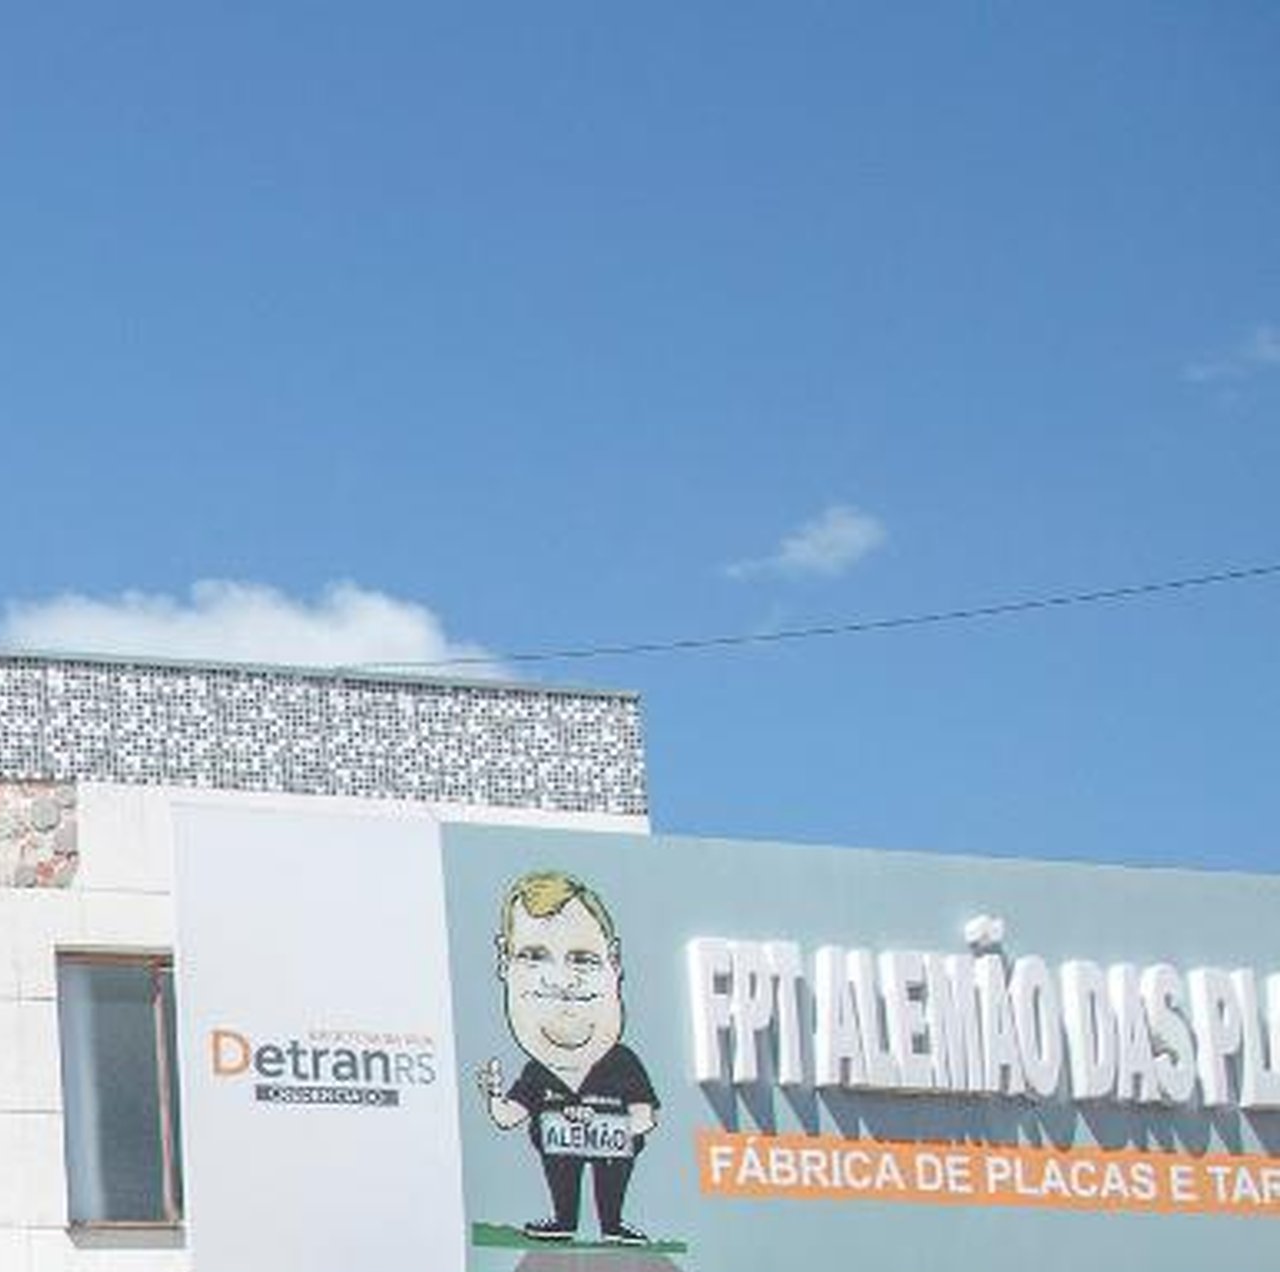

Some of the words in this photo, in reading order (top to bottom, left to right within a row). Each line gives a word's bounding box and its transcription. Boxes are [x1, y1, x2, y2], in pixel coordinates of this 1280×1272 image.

[687, 937, 802, 1084] FPT
[814, 914, 1064, 1097] ALEMÃO
[1061, 960, 1196, 1102] DAS
[1188, 966, 1280, 1107] PL
[709, 1136, 906, 1192] FÁBRICA
[915, 1153, 973, 1193] DE
[985, 1156, 1157, 1203] PLACAS
[1170, 1164, 1198, 1202] E
